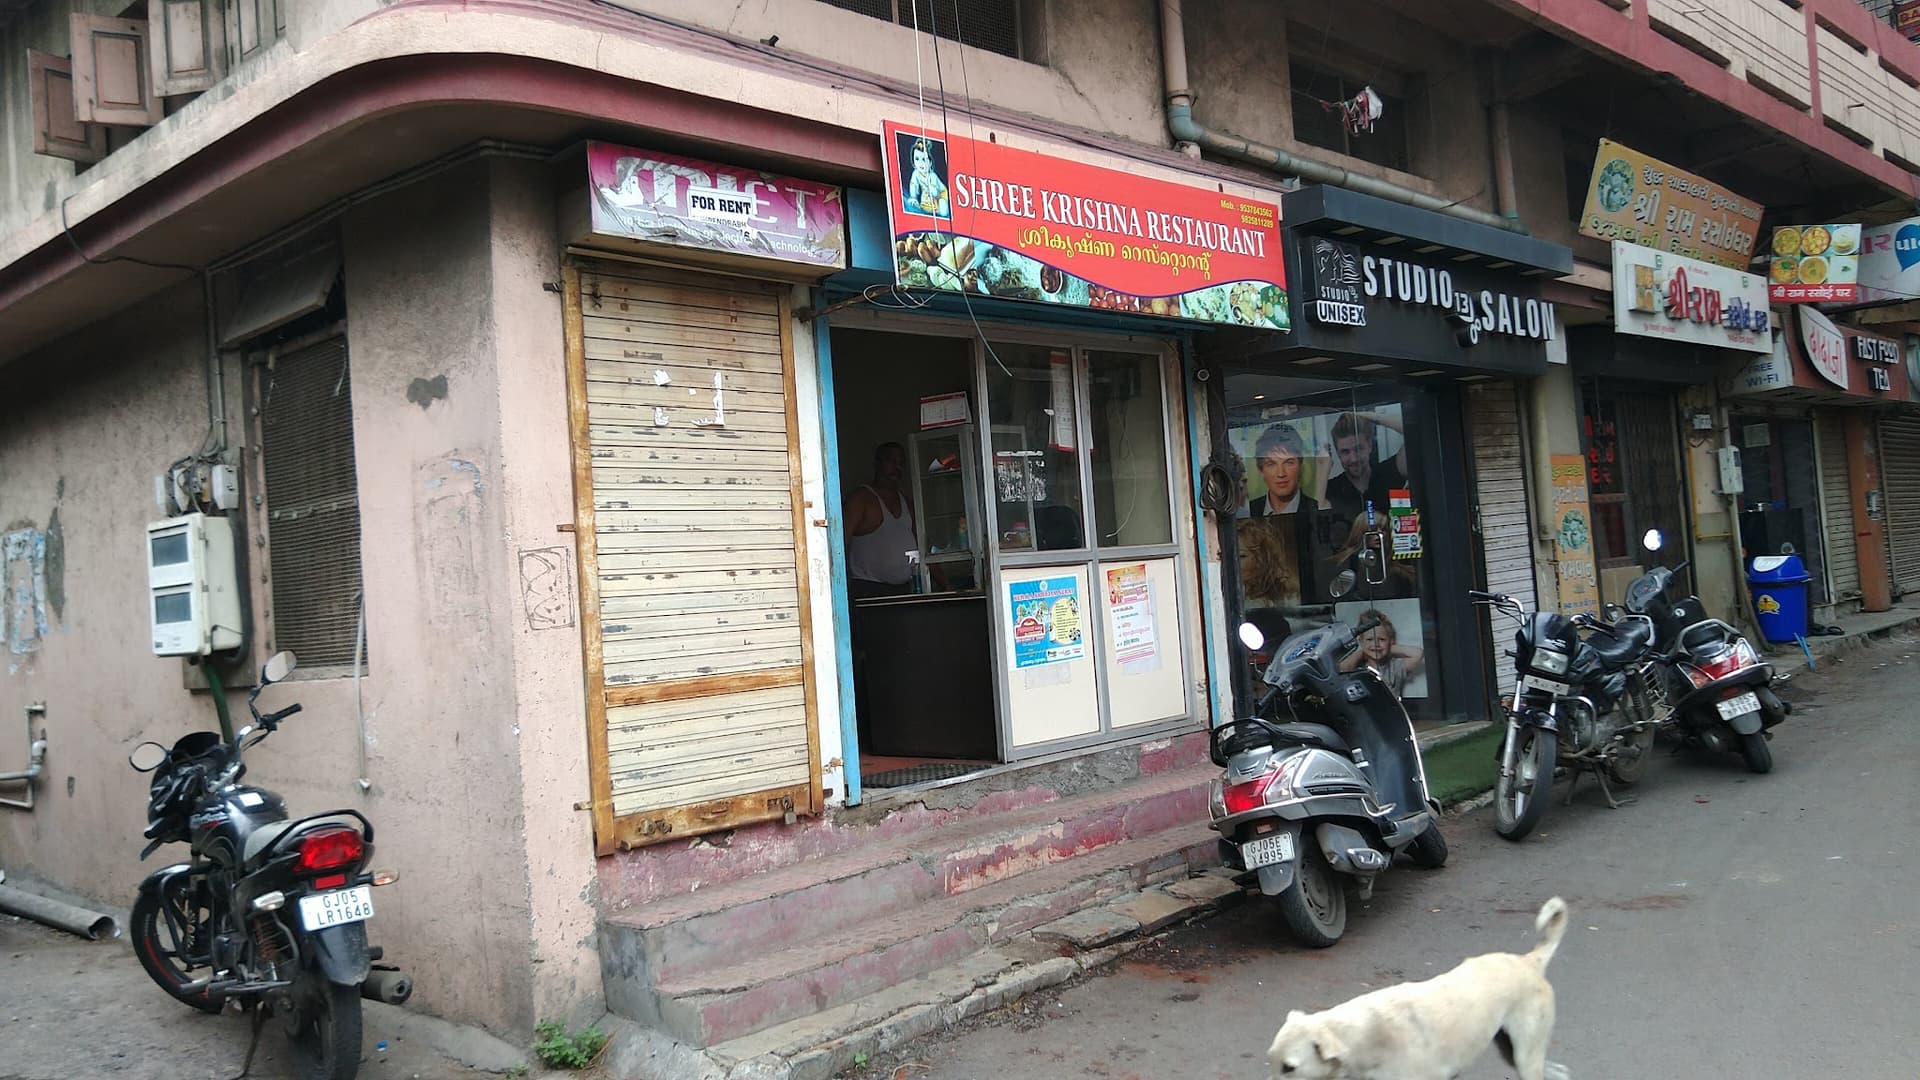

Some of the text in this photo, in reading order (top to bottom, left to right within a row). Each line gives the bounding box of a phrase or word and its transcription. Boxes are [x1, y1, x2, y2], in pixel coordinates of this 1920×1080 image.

[691, 195, 751, 216] FOR RENT
[955, 173, 1265, 258] SHREE KRISHNA RESTAURANT
[1634, 188, 1661, 226] શ્રી
[1665, 204, 1697, 238] રામ
[1320, 285, 1350, 302] STUDIO
[1362, 255, 1556, 341] STUDIO 13 SALON
[1668, 266, 1690, 319] શ્રી
[1692, 286, 1723, 325] રામ
[1318, 301, 1364, 325] UNISEX
[1857, 336, 1879, 361] FAST
[1879, 339, 1900, 365] FOOD
[1745, 373, 1779, 388] WI-FI
[1872, 367, 1891, 391] TEA
[1250, 836, 1281, 854] GJ05E
[322, 890, 359, 908] GJ05
[317, 902, 371, 926] LR1648
